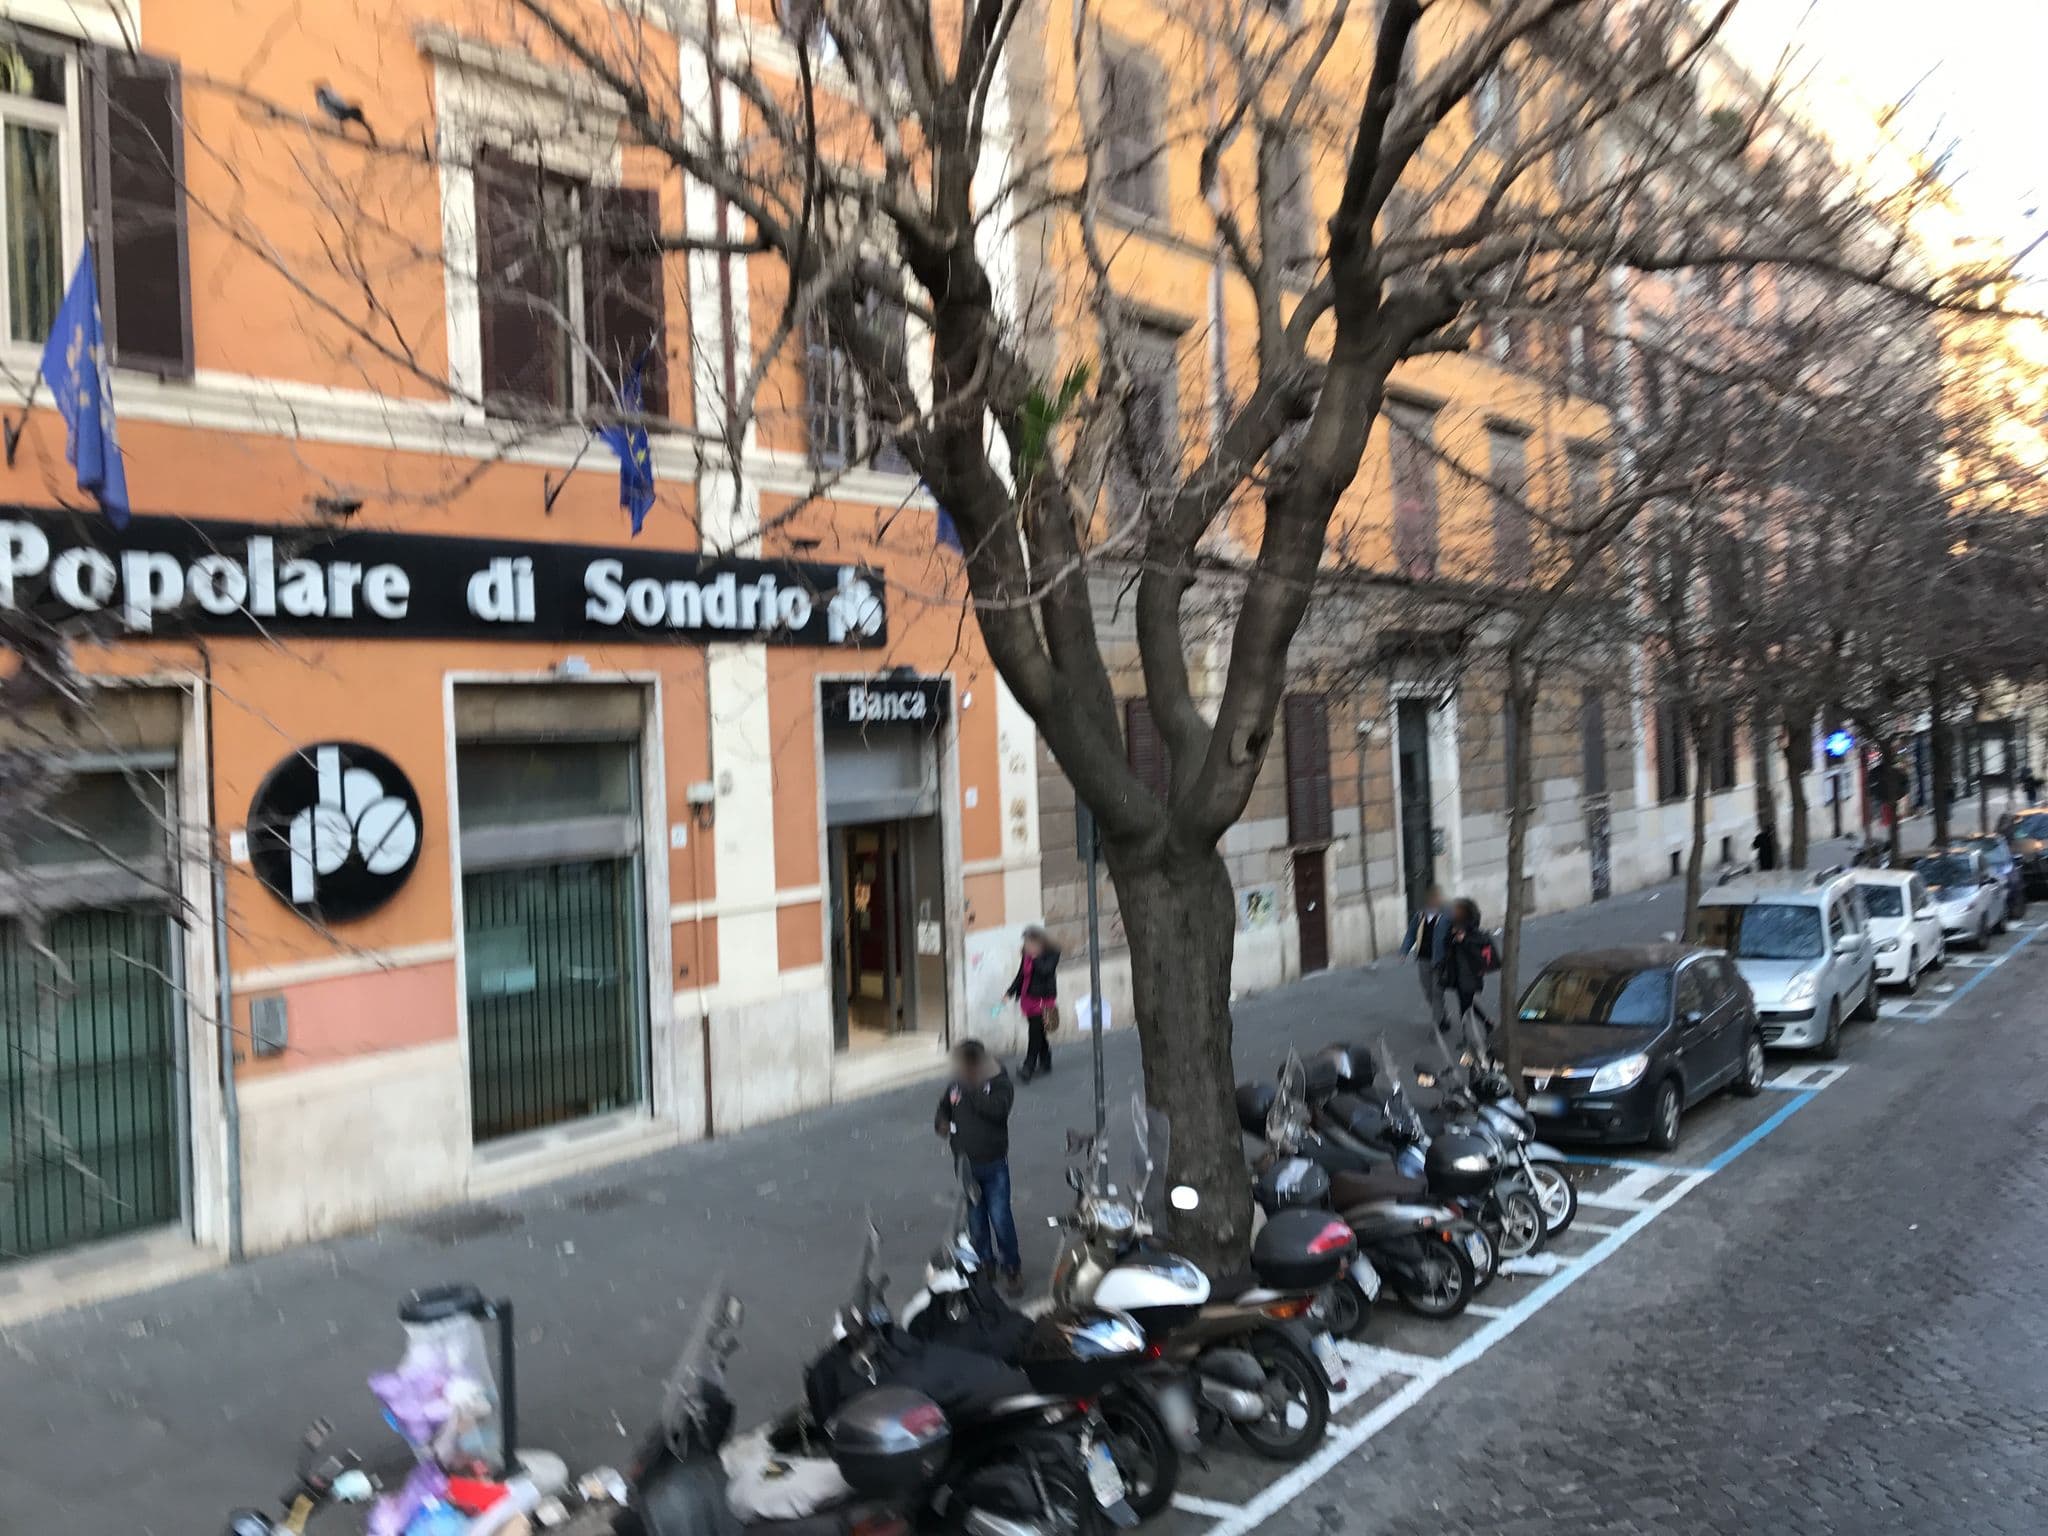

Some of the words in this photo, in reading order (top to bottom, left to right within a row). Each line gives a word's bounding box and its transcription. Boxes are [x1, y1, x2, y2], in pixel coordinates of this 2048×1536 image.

[0, 519, 411, 633] Popolare
[466, 555, 536, 622] di
[584, 558, 813, 631] Sondrio
[847, 685, 926, 721] Banca
